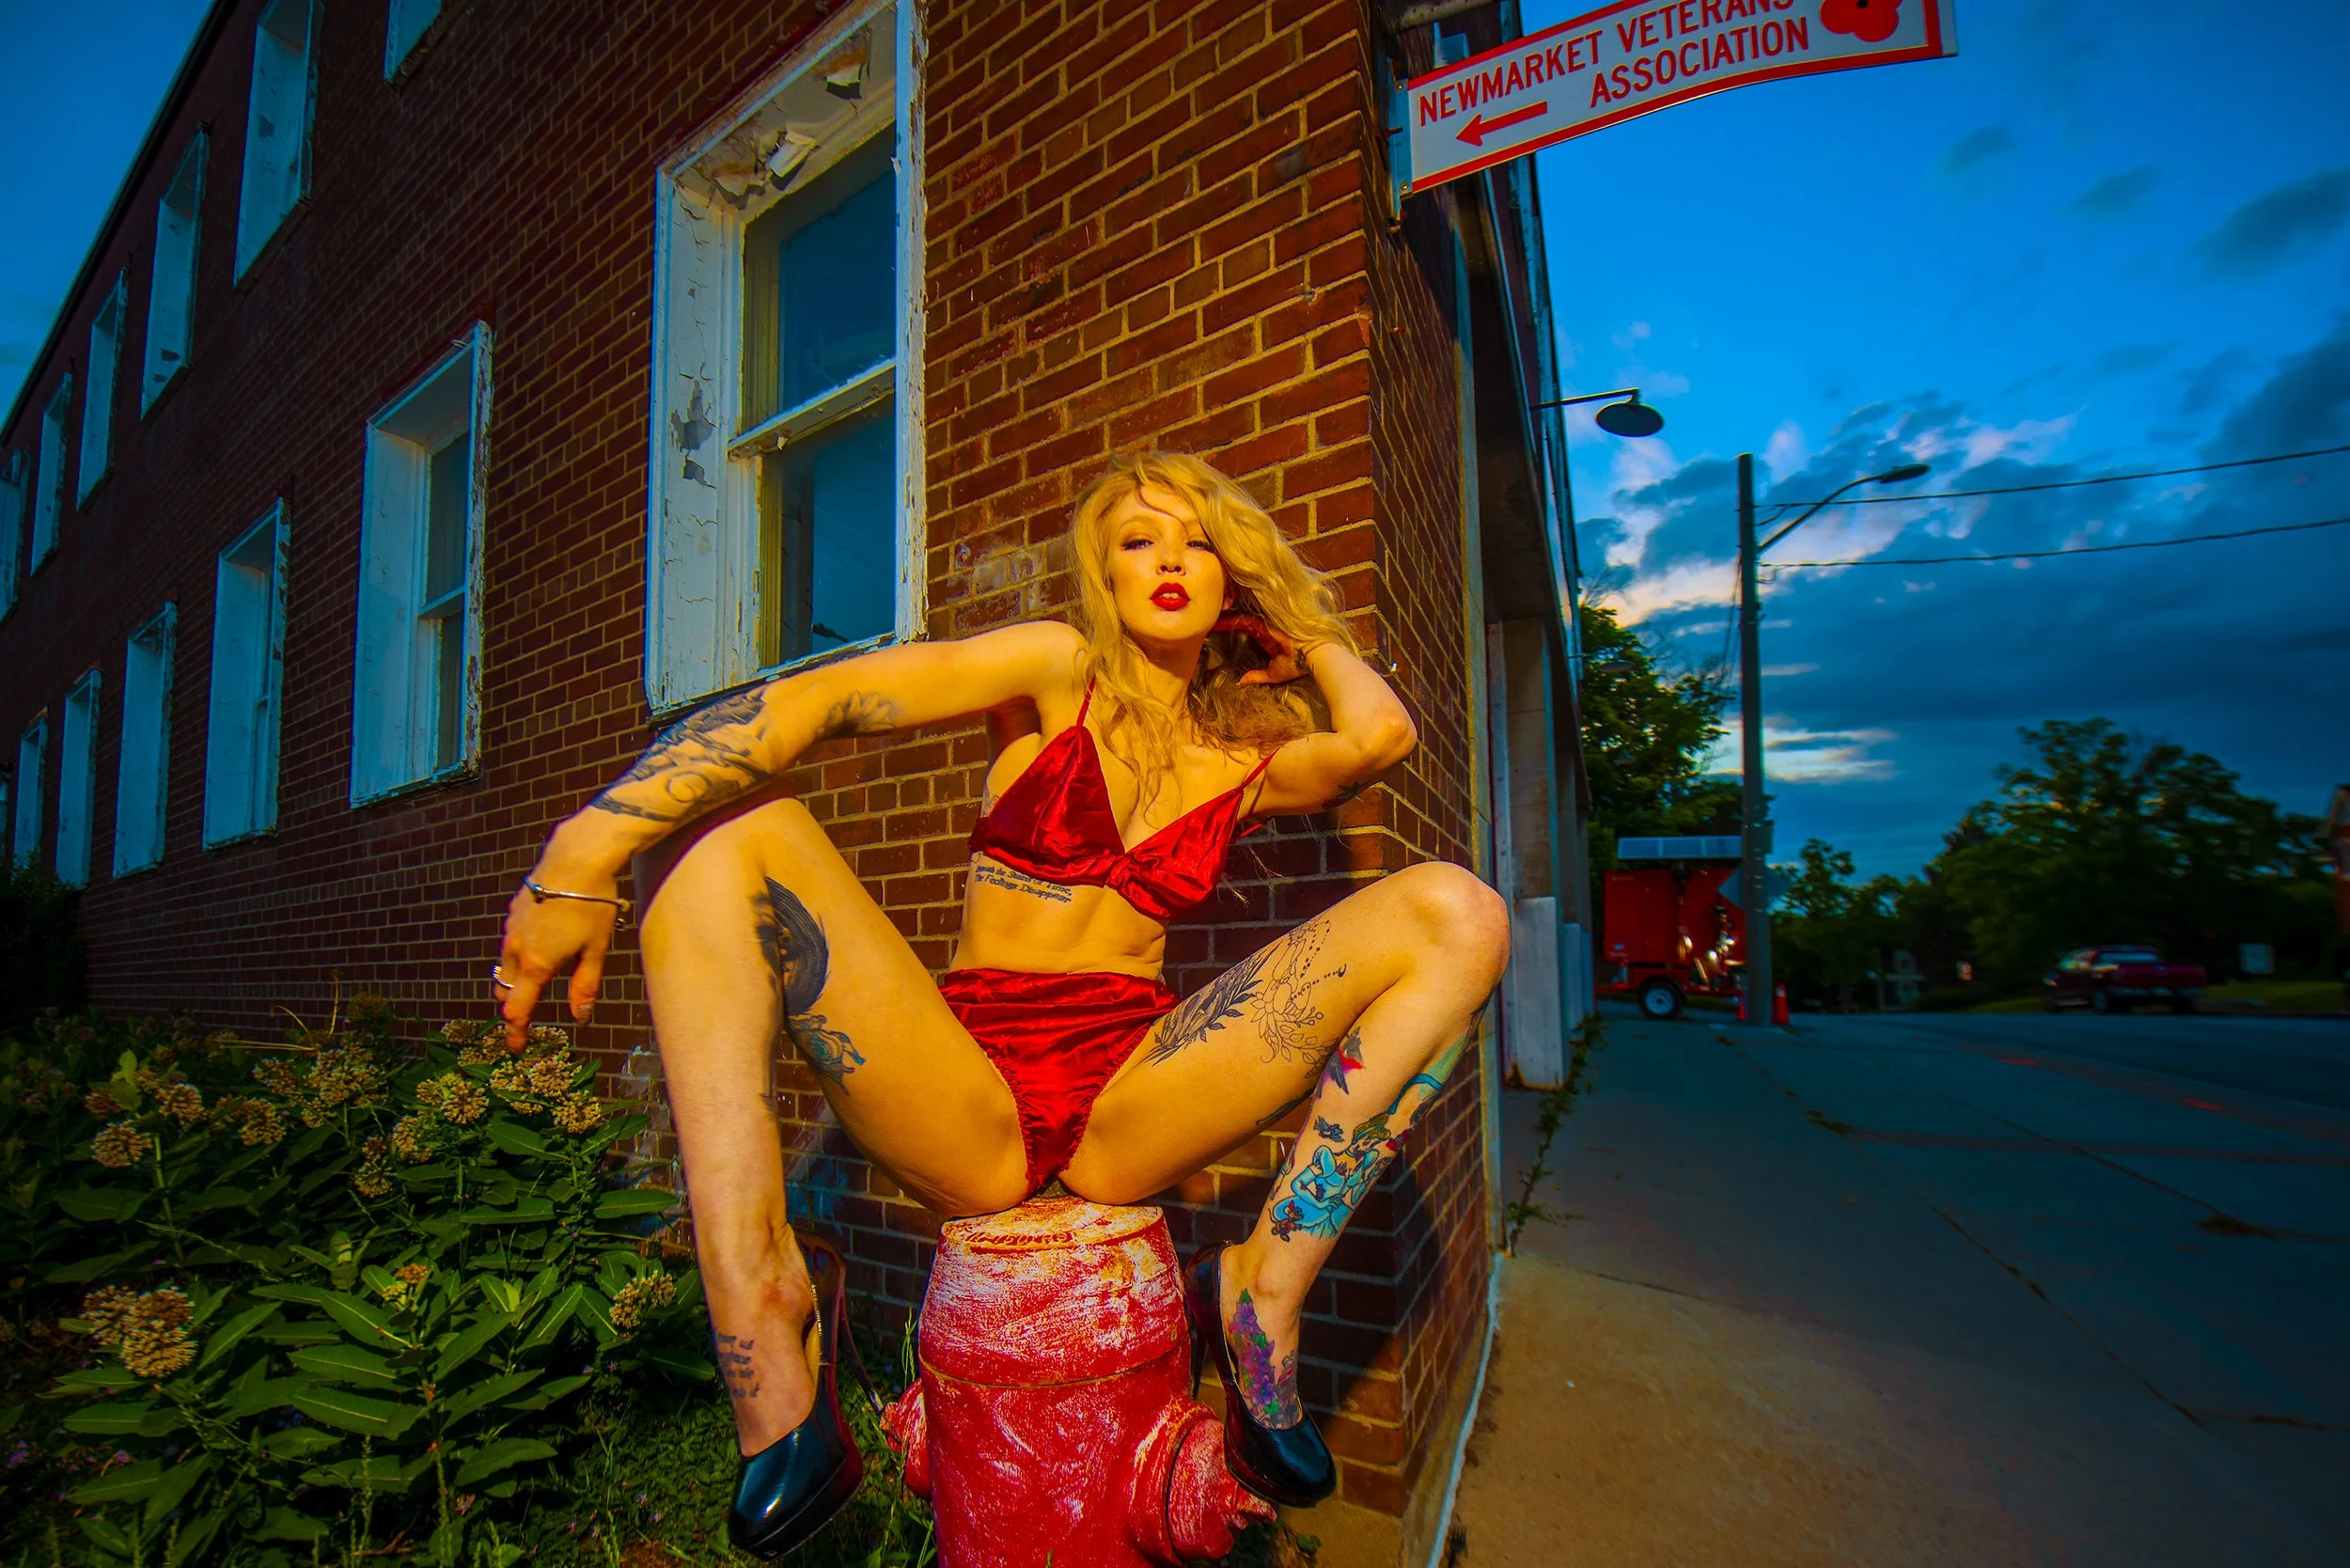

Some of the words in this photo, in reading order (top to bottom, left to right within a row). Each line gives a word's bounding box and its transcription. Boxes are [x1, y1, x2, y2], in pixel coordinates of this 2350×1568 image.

[1419, 29, 1603, 127] NEWMARKET
[1590, 16, 1810, 108] ASSOCIATION
[1019, 884, 1072, 902] Disappear
